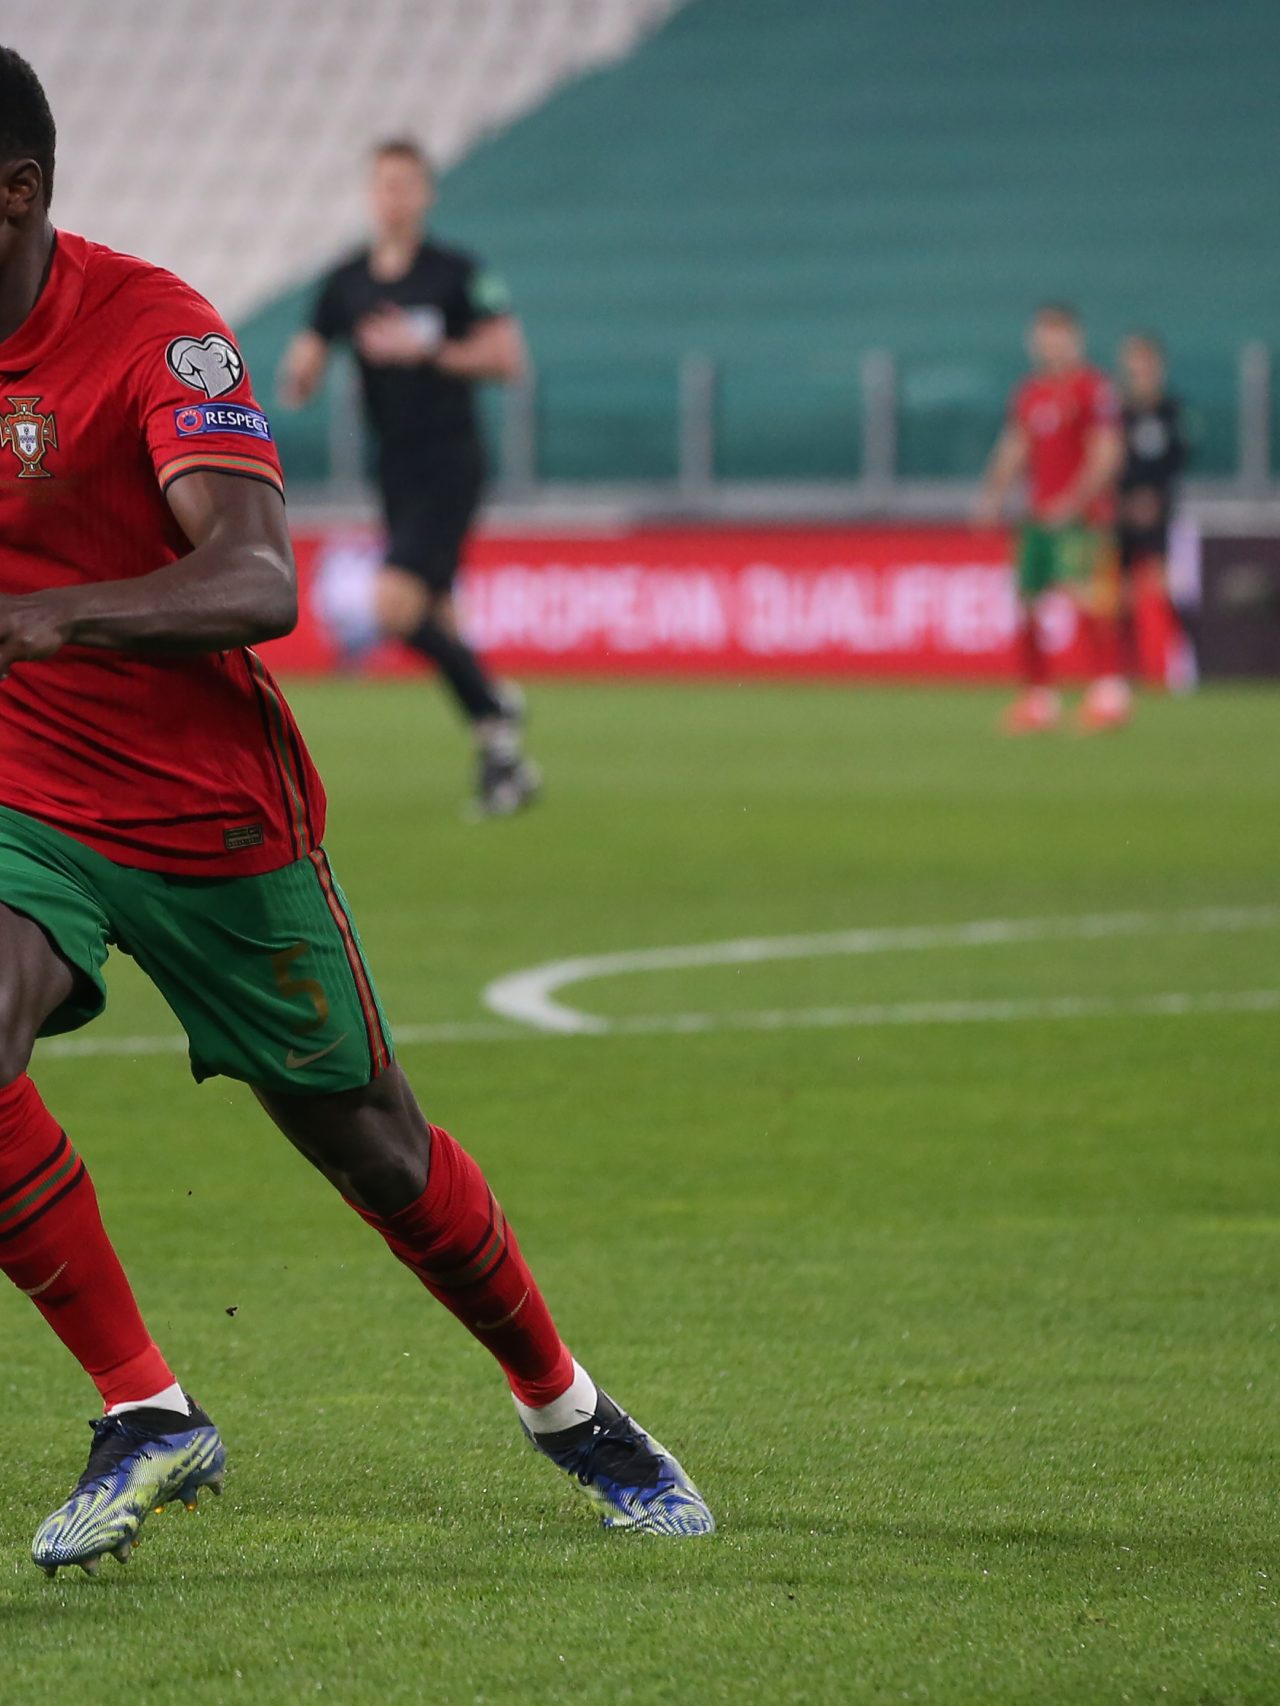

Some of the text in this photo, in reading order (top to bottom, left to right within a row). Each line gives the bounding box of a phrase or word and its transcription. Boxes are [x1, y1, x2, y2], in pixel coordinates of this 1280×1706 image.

[205, 410, 269, 433] RESPECT
[453, 563, 727, 652] UROPEAN
[272, 943, 329, 1033] 5
